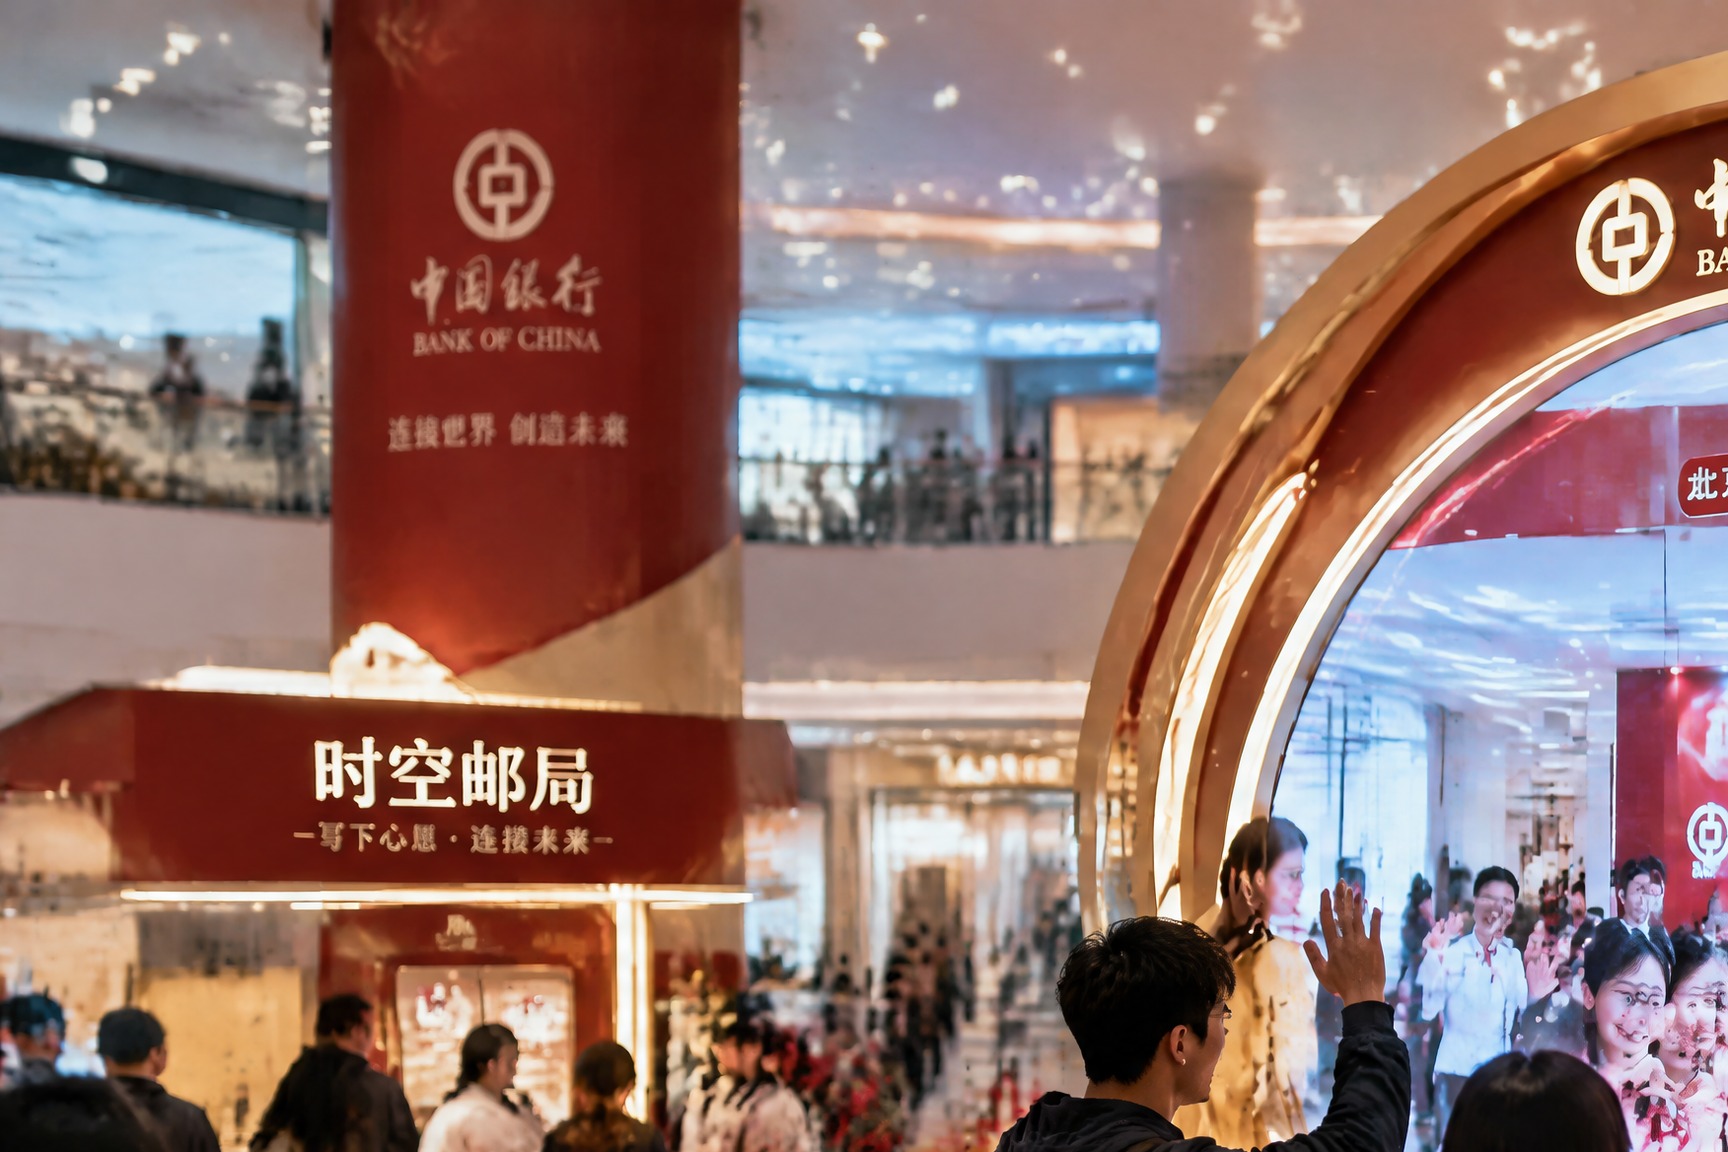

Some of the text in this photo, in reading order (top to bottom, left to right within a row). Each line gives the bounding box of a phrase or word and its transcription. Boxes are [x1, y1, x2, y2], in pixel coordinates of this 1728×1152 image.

[413, 326, 602, 357] BANK OF CHINA
[314, 736, 593, 814] 时空邮局
